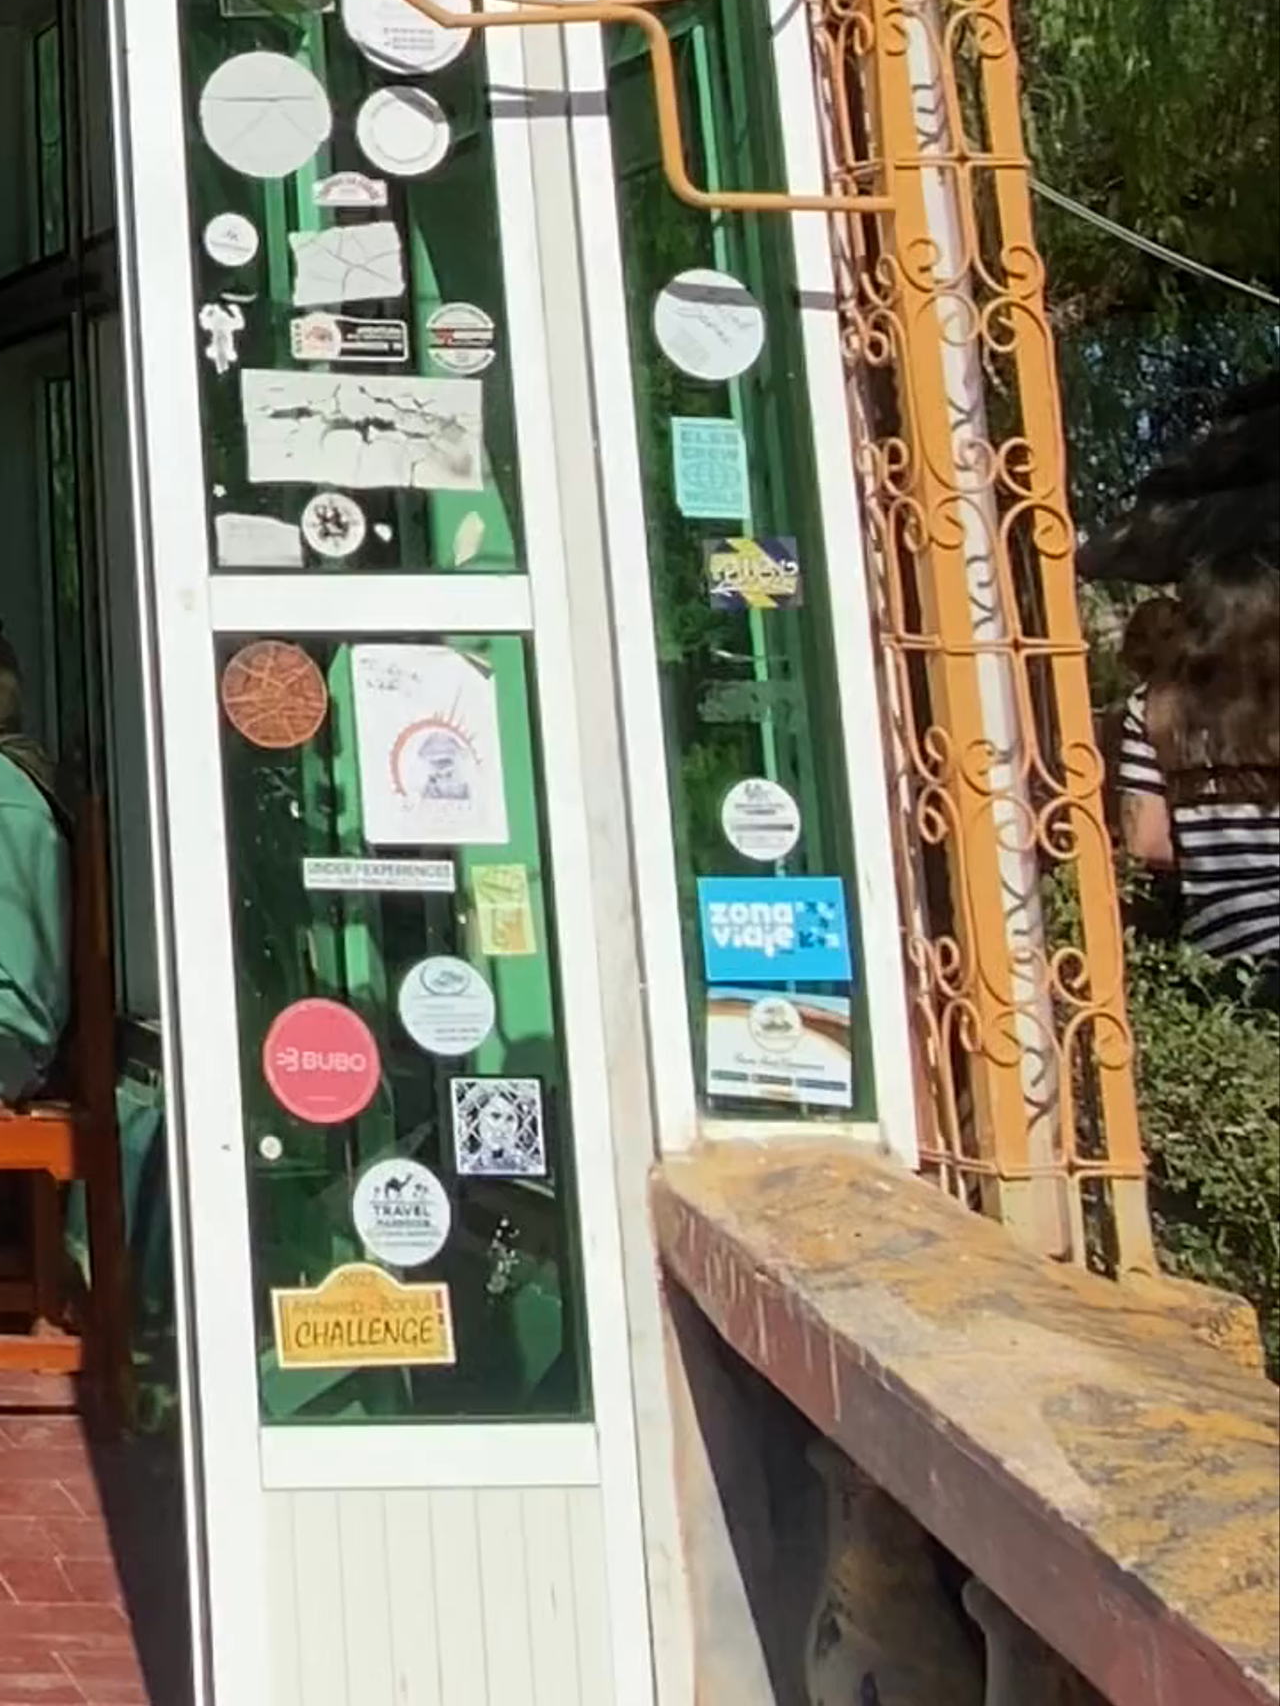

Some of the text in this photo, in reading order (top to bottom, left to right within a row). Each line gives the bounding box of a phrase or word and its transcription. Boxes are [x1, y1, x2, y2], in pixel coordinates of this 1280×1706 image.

[708, 901, 794, 925] zona
[711, 926, 794, 959] viaje
[301, 1050, 368, 1073] BUBO
[372, 1204, 432, 1217] TRAVEL
[294, 1316, 435, 1349] CHALLENGE
